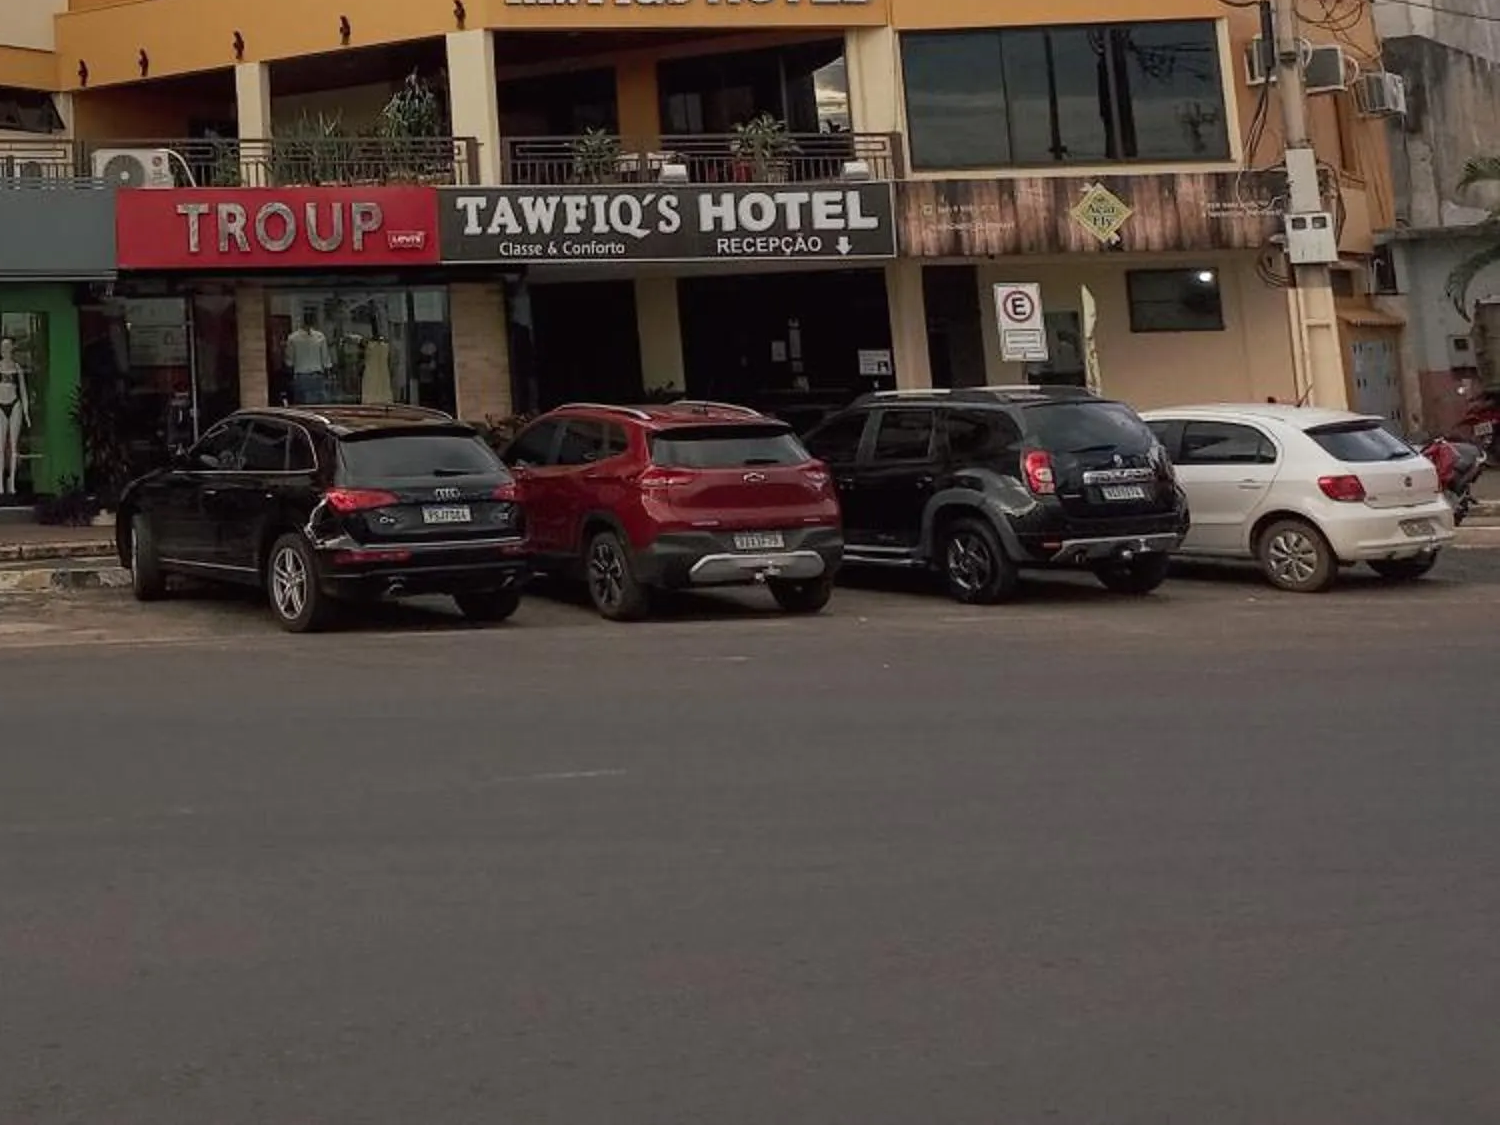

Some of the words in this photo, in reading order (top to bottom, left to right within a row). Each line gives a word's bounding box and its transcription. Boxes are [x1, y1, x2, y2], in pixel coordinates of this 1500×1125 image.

[700, 190, 880, 232] HOTEL
[176, 201, 384, 253] TROUP
[499, 241, 543, 256] Classe
[547, 241, 558, 256] &
[563, 240, 625, 255] Conforto
[717, 232, 823, 256] RECEPÇÃO
[1011, 296, 1027, 316] E
